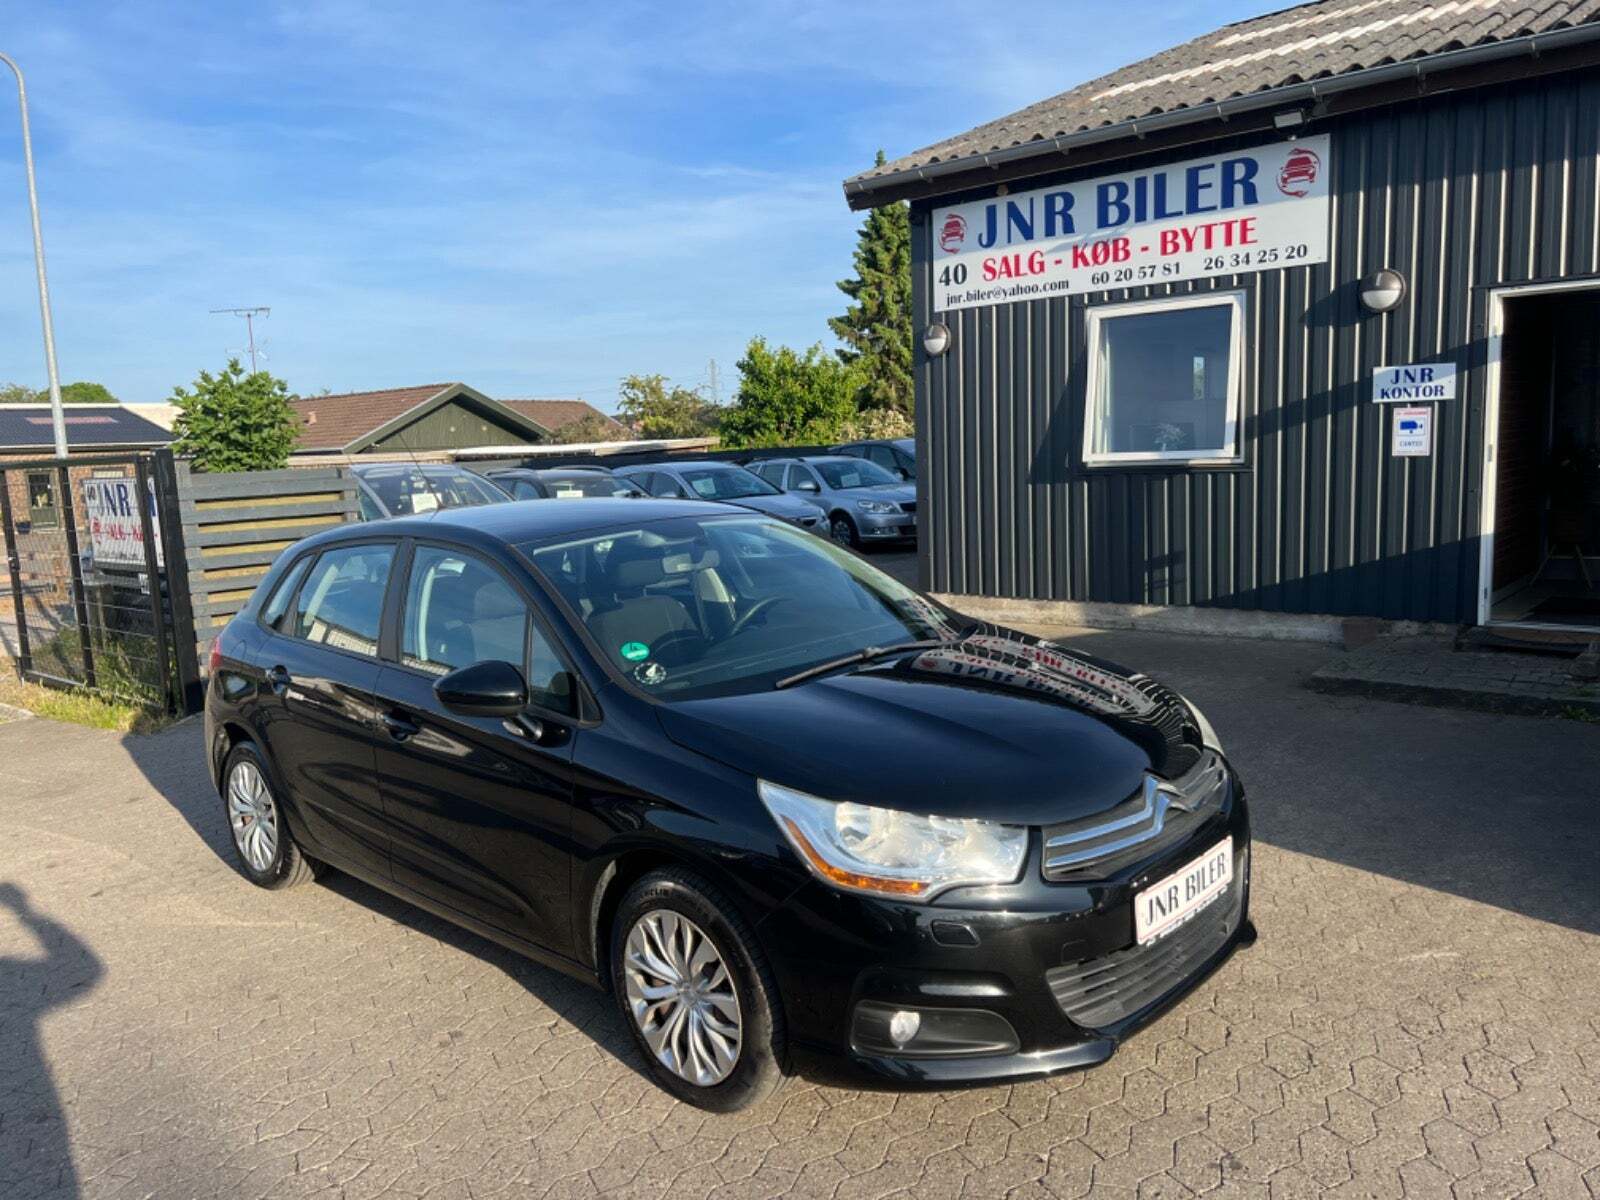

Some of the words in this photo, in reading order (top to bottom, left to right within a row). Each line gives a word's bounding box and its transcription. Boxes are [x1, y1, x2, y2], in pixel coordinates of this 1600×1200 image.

[978, 191, 1076, 249] JNR
[1096, 156, 1259, 230] BILER
[982, 250, 1046, 282] SALG
[1072, 237, 1131, 269] KØB
[1160, 217, 1258, 256] BYTTE
[1091, 271, 1110, 285] 60
[1114, 267, 1133, 282] 20
[1137, 264, 1157, 279] 57
[1161, 261, 1181, 276] 81
[1203, 255, 1225, 270] 26
[1230, 252, 1251, 267] 34
[1256, 248, 1279, 263] 25
[1285, 244, 1308, 259] 20
[938, 262, 968, 287] 40
[946, 278, 1070, 307] jnr.biler@yahoo.com
[1380, 385, 1445, 400] KONTOR
[1390, 367, 1435, 385] JNR
[1145, 885, 1179, 927] JNR
[1185, 852, 1227, 902] BILER
